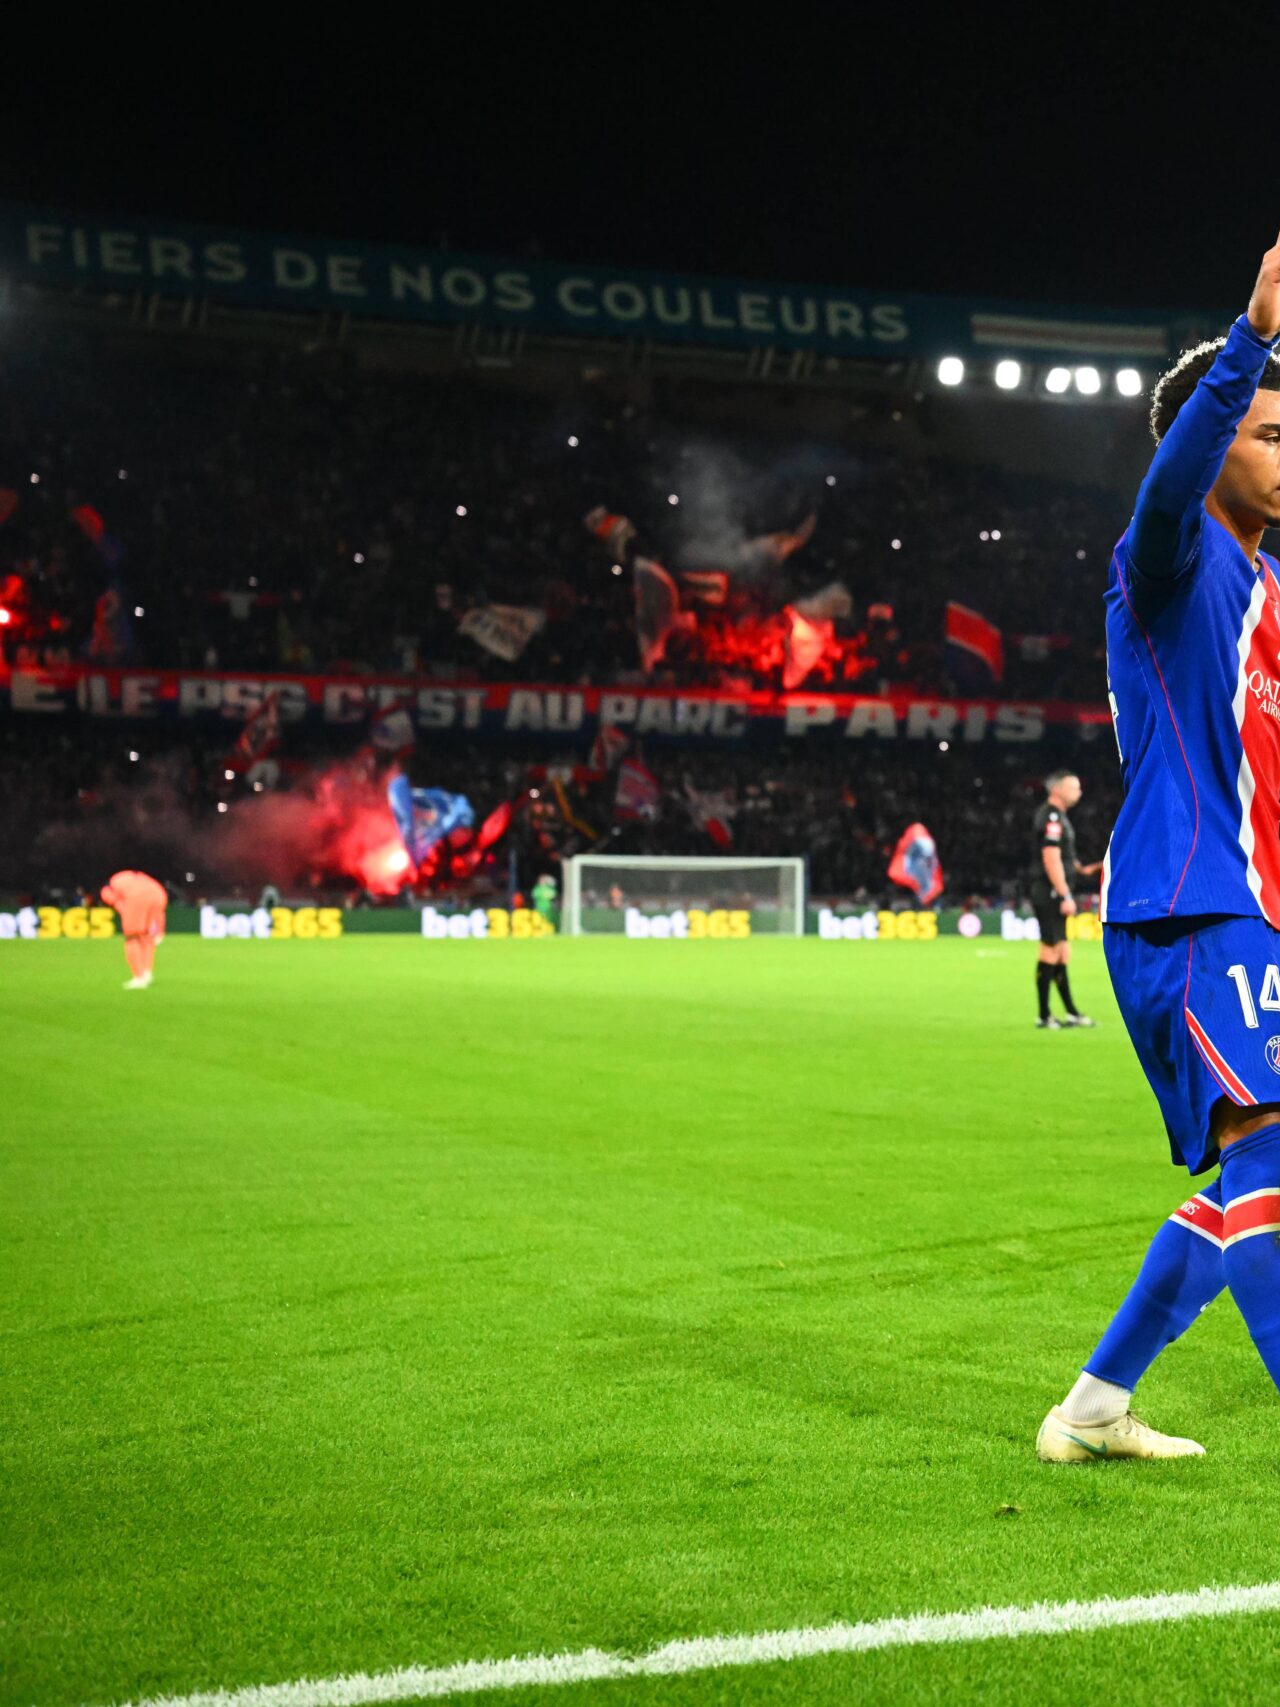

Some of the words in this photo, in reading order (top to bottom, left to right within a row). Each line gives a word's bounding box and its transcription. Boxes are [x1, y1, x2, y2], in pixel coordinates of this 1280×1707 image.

[27, 224, 248, 283] FIERS
[273, 248, 369, 297] DE
[391, 264, 535, 311] NOS
[557, 277, 909, 342] COULEURS
[505, 689, 585, 733] AU
[601, 694, 748, 738] PARC
[784, 698, 1046, 742] PARIS
[0, 906, 115, 938] et365
[201, 906, 343, 939] bet365
[421, 906, 555, 938] bet365
[625, 908, 751, 938] bet365
[818, 909, 938, 939] bet365
